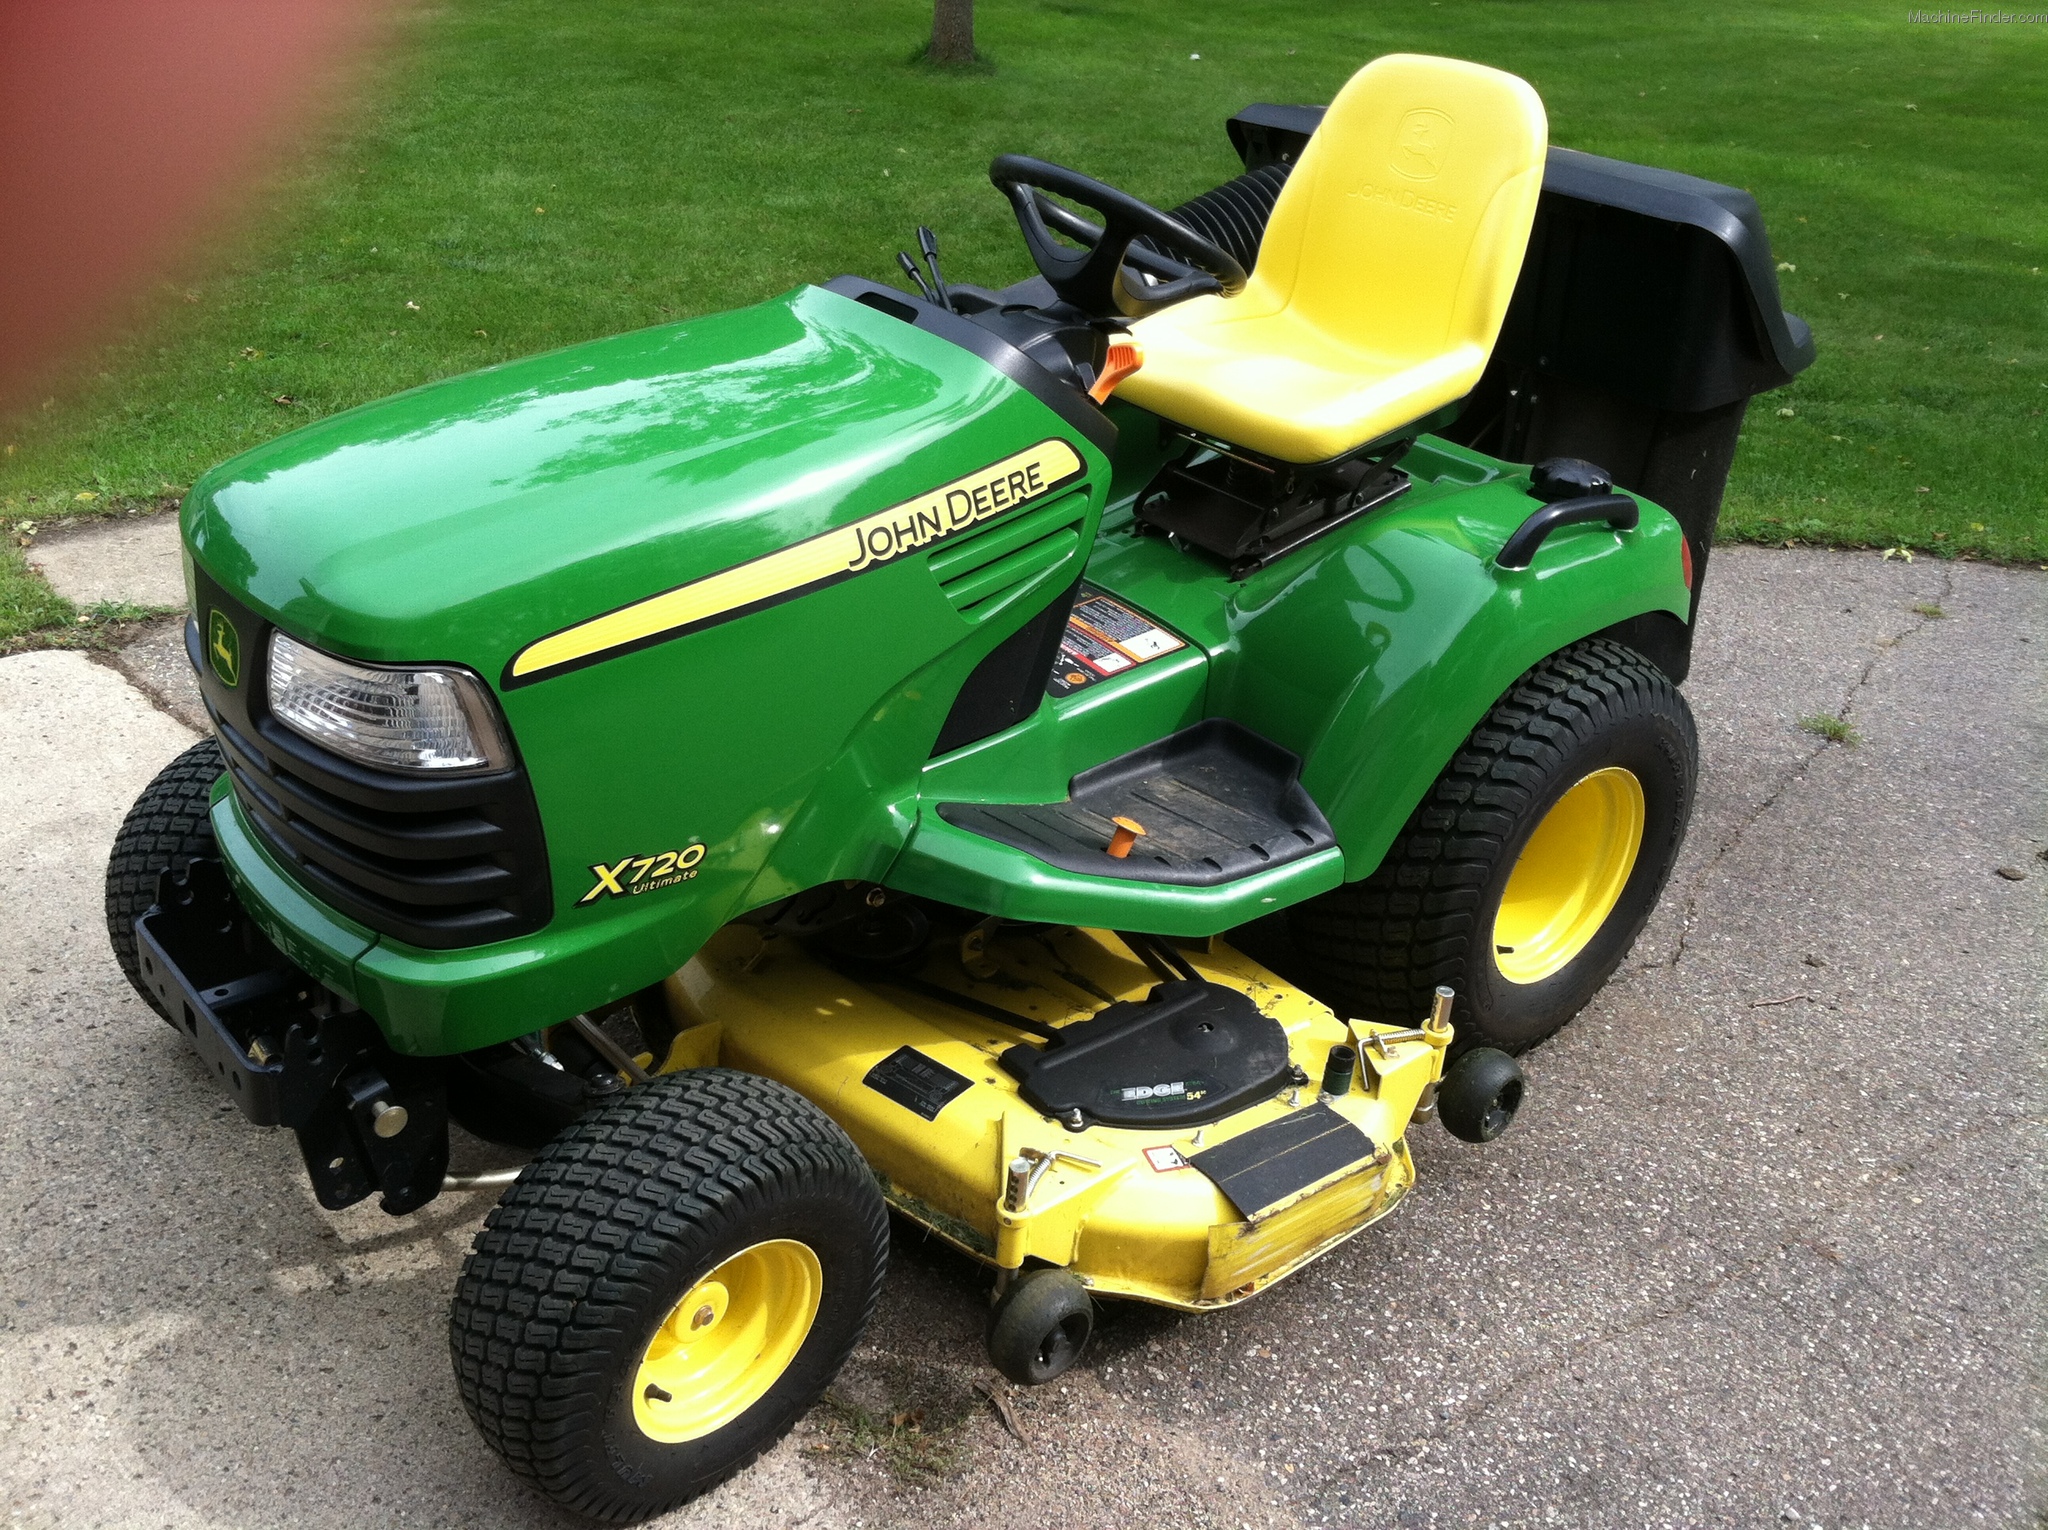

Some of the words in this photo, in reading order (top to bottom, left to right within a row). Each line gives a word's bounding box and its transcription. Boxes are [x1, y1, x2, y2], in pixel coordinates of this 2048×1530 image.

[1400, 189, 1457, 223] DEERE
[848, 505, 942, 568] JOHN
[945, 461, 1045, 527] DEERE
[574, 842, 707, 907] X720
[632, 869, 698, 895] Ultimate
[1121, 1081, 1184, 1102] EDGE
